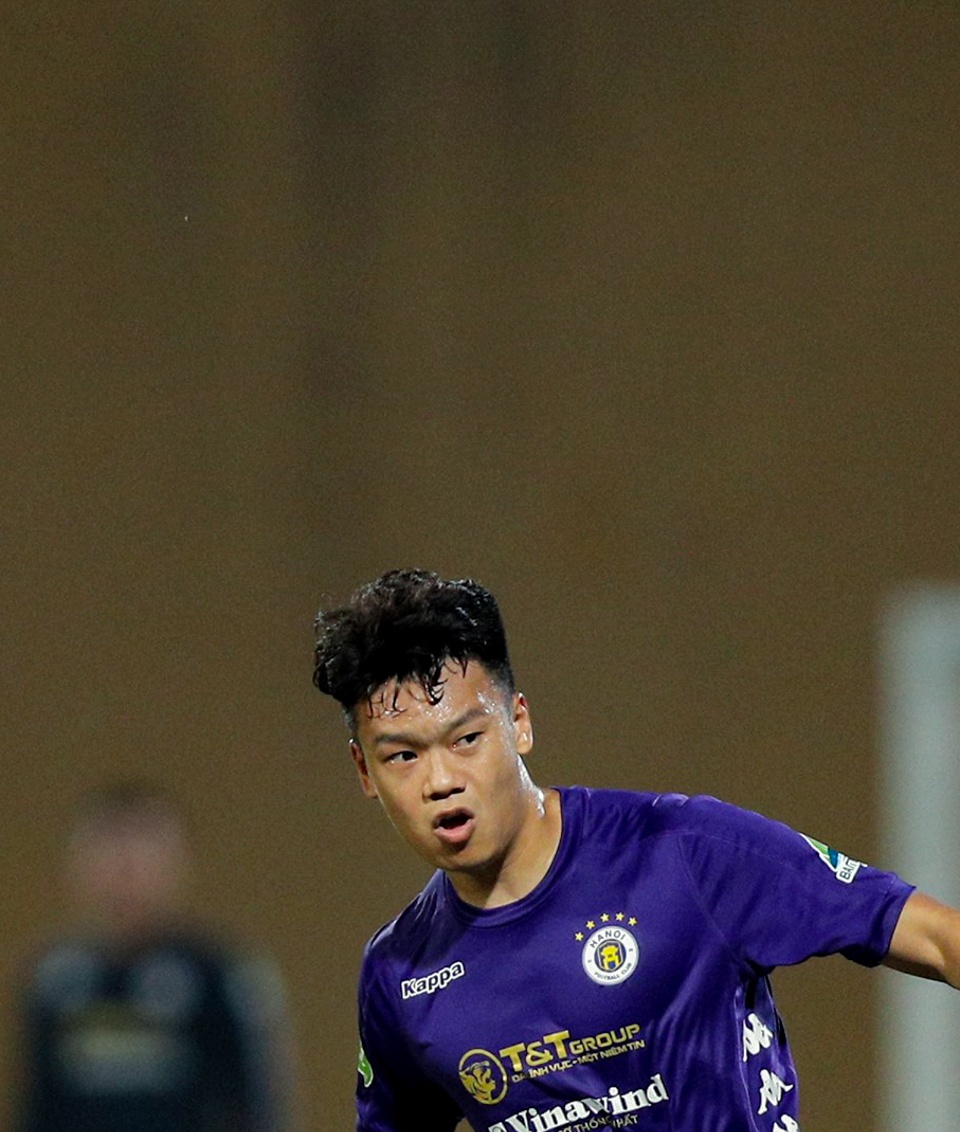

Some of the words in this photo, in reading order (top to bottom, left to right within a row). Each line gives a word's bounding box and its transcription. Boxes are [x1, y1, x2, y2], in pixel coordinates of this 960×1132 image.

[589, 929, 626, 949] HANOI
[401, 961, 465, 999] Kappa
[499, 1029, 571, 1072] T&T
[568, 1023, 641, 1055] GROUP
[626, 1039, 646, 1051] TIN
